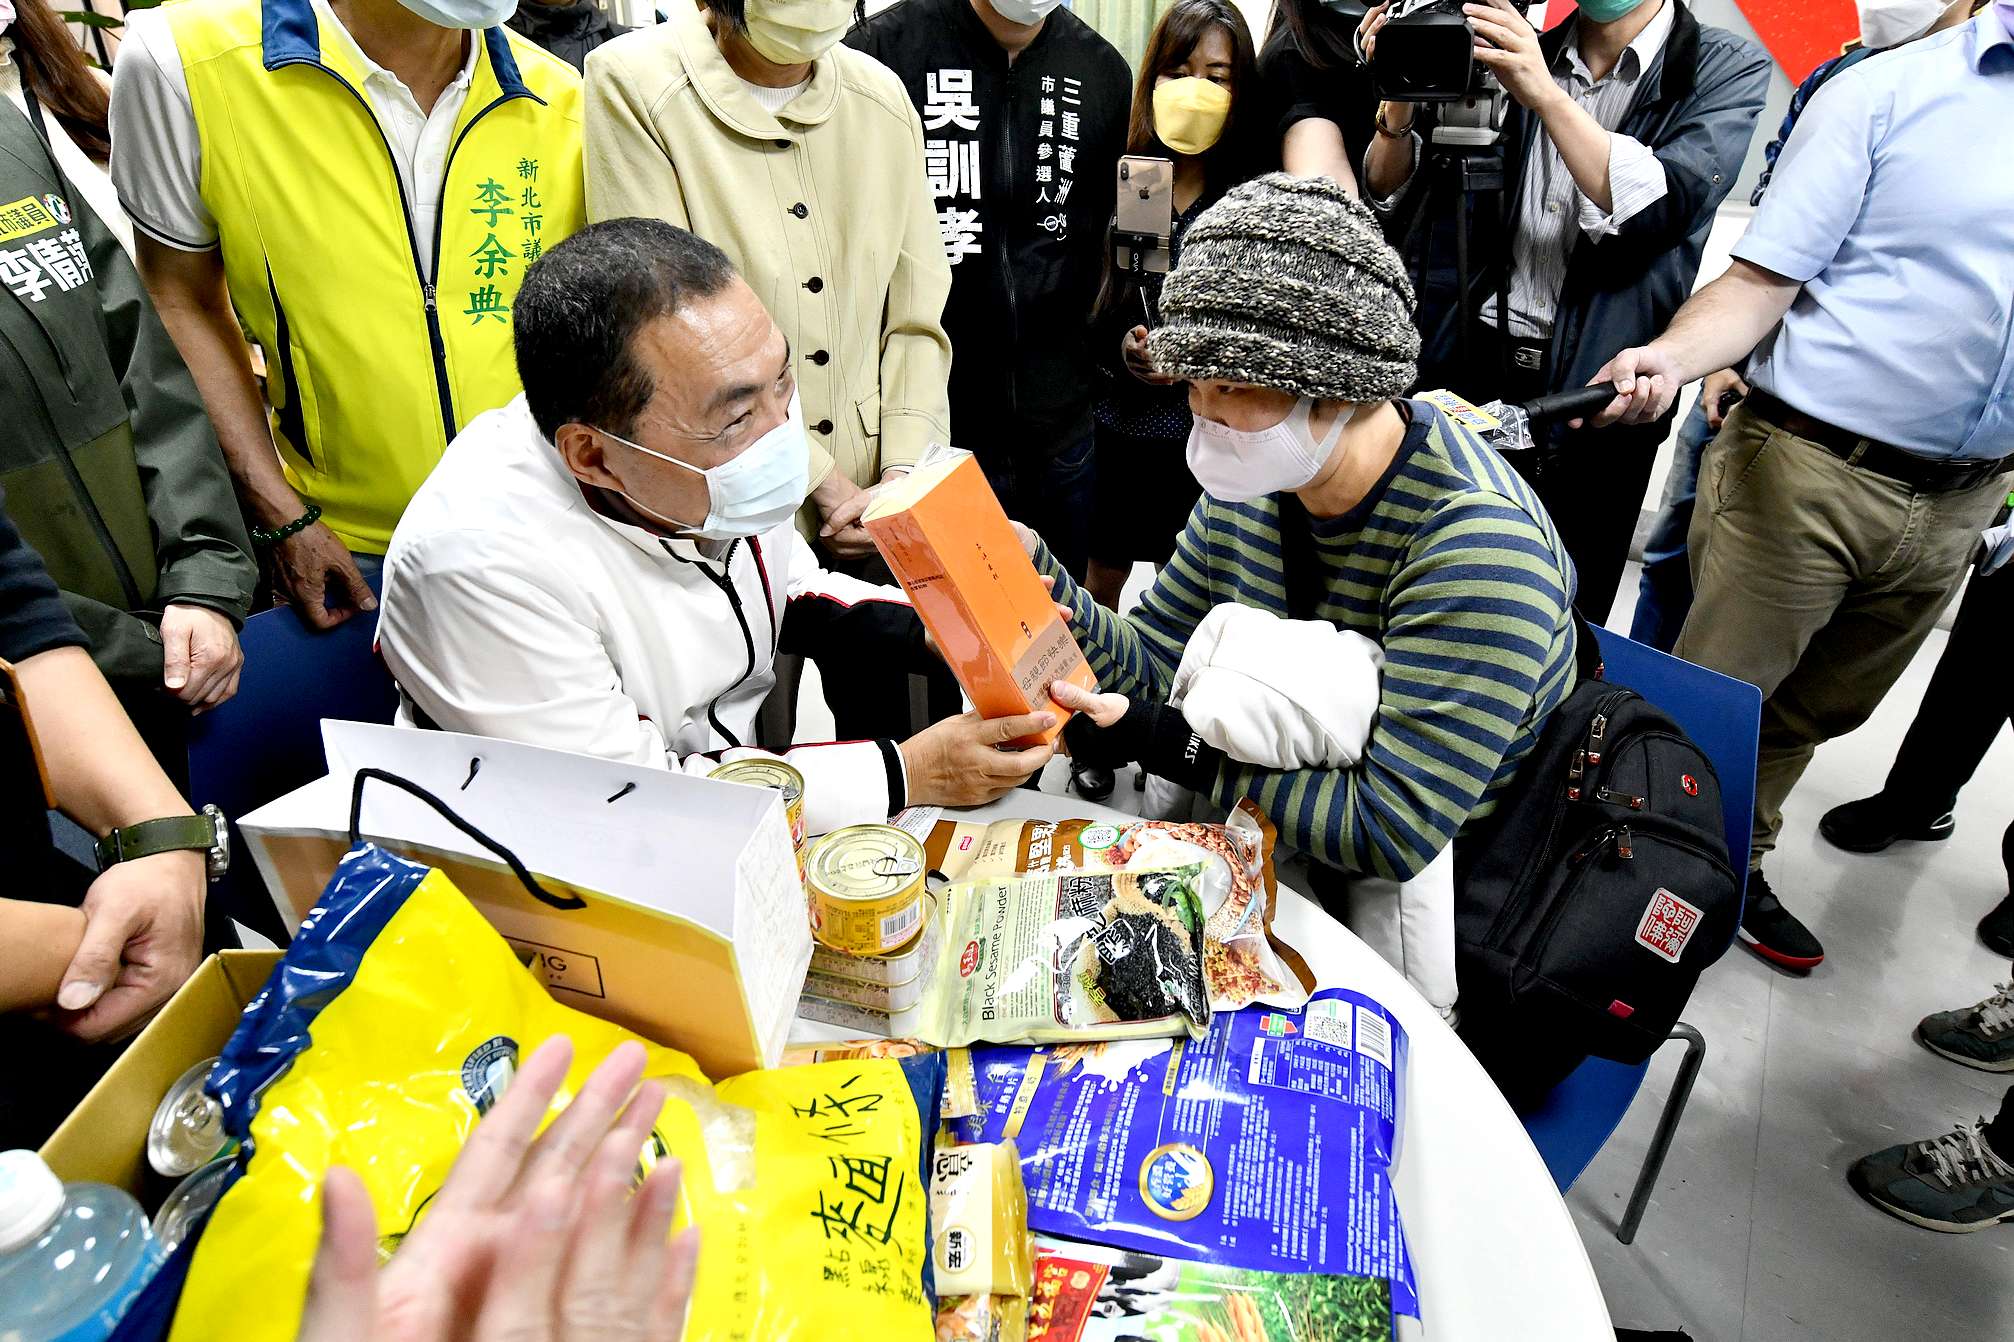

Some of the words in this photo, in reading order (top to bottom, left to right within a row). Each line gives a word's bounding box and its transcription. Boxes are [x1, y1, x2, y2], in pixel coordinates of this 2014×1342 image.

[1035, 75, 1056, 204] 市議員參選人
[1053, 77, 1082, 206] 三重蘆洲
[463, 177, 518, 326] 李余典
[516, 157, 543, 276] 新北市議
[985, 933, 1002, 981] Sesame
[992, 886, 1008, 932] Powder
[981, 982, 996, 1021] Black
